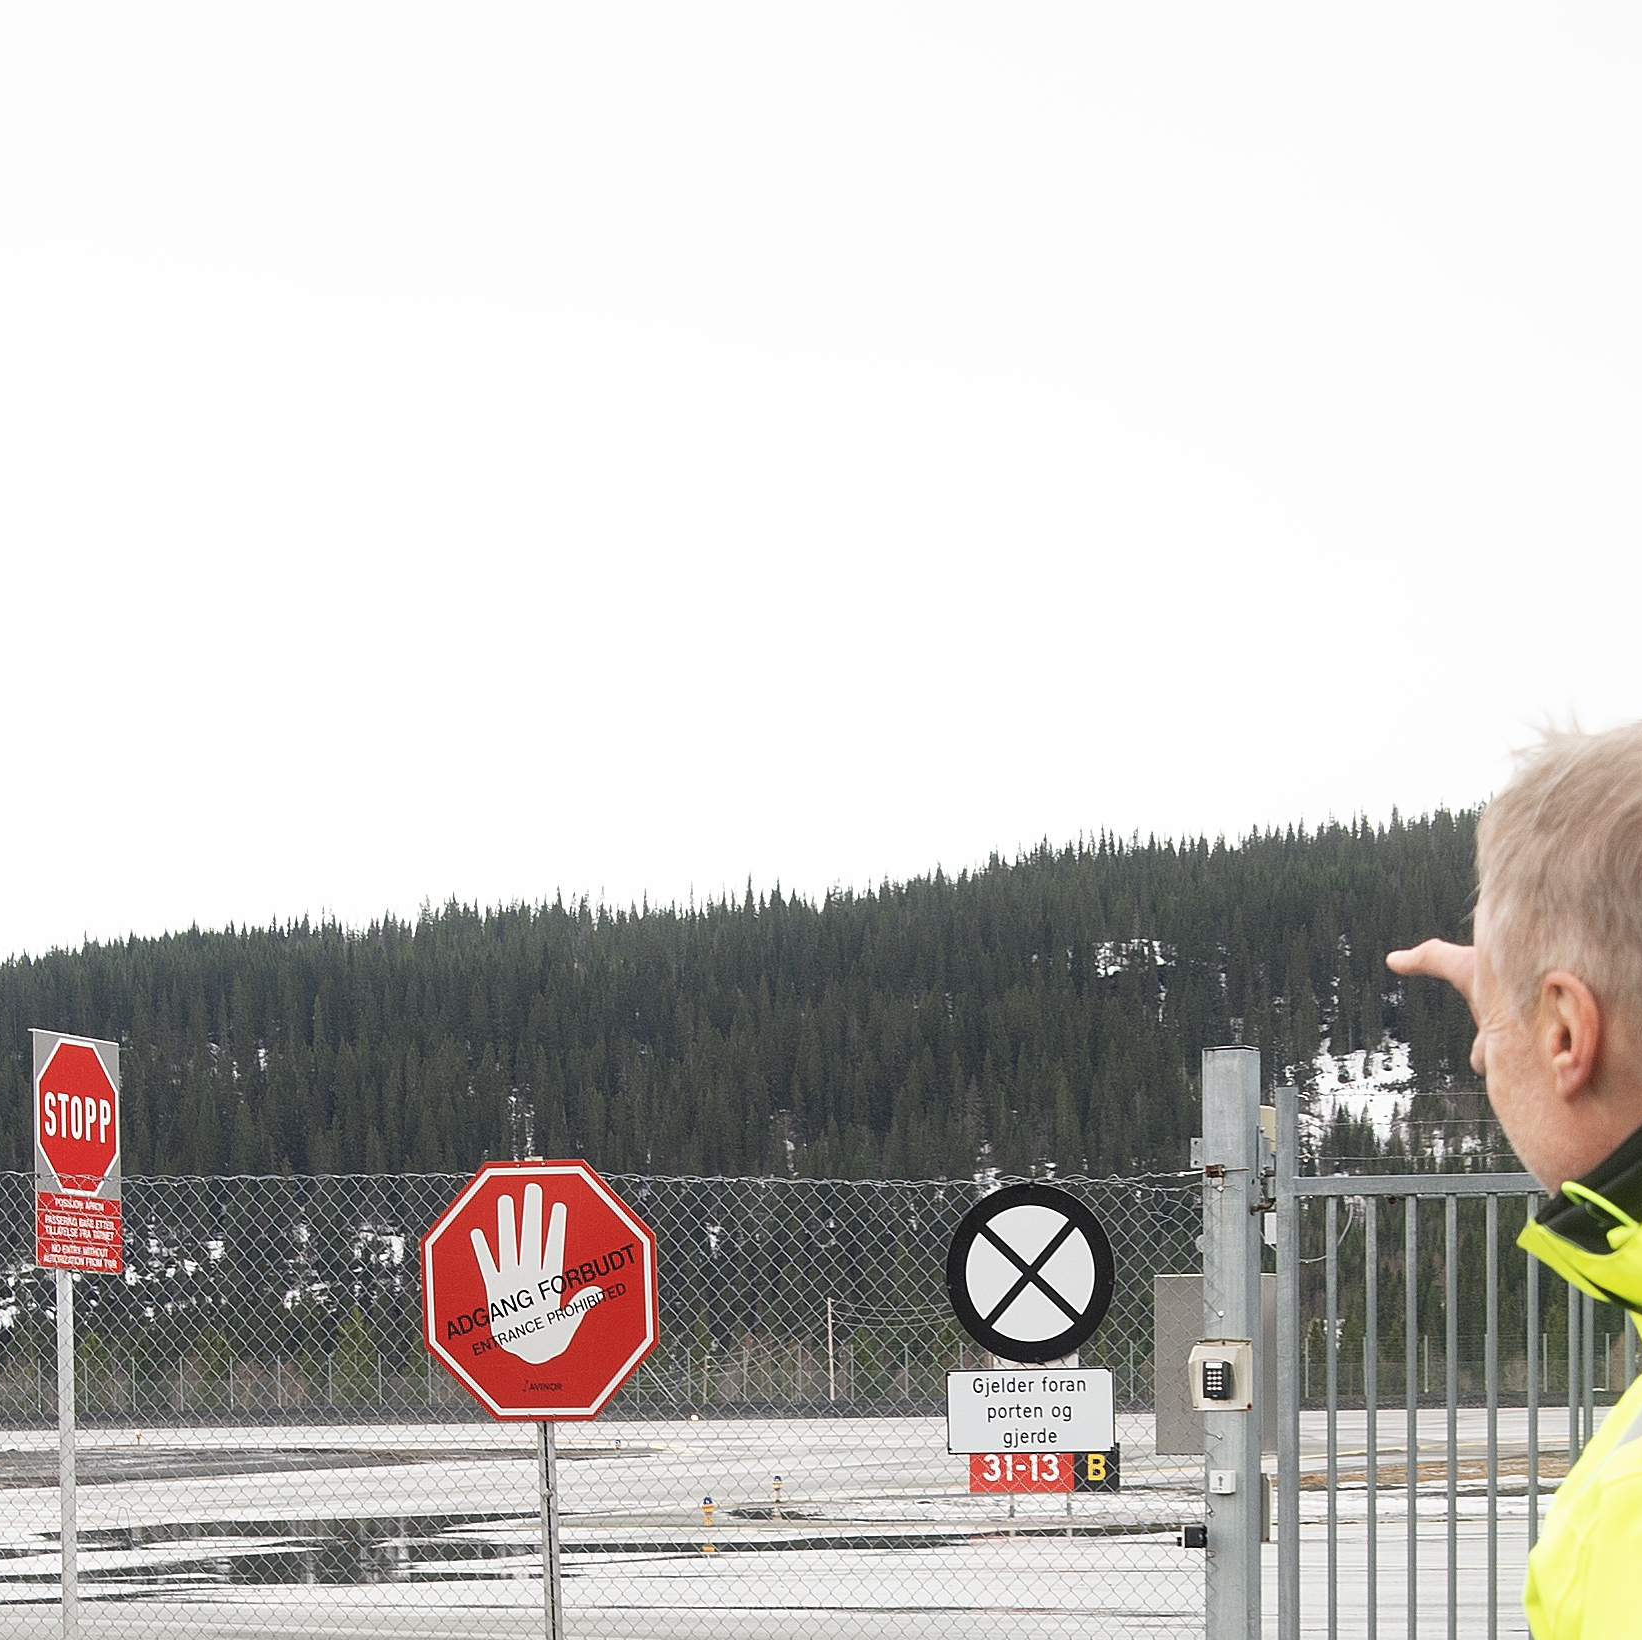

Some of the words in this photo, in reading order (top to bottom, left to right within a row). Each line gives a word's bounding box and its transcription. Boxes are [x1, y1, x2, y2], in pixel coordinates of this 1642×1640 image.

[44, 1091, 111, 1144] STOPP
[45, 1214, 77, 1227] PASSERING
[79, 1228, 92, 1238] FRA
[51, 1243, 61, 1253] NO
[85, 1257, 103, 1267] FROM
[446, 1289, 534, 1340] ADGANG
[538, 1244, 636, 1301] FORBUDT
[472, 1316, 545, 1356] ENTRANCE
[547, 1282, 627, 1326] PROHIBITED
[529, 1383, 563, 1391] AVINOR
[972, 1377, 1035, 1397] Gjelder
[1041, 1377, 1087, 1393] foran
[987, 1404, 1043, 1423] porten
[1051, 1406, 1072, 1423] og
[1002, 1429, 1058, 1448] gjerde
[982, 1454, 1060, 1482] 31-13
[1087, 1454, 1106, 1482] B
